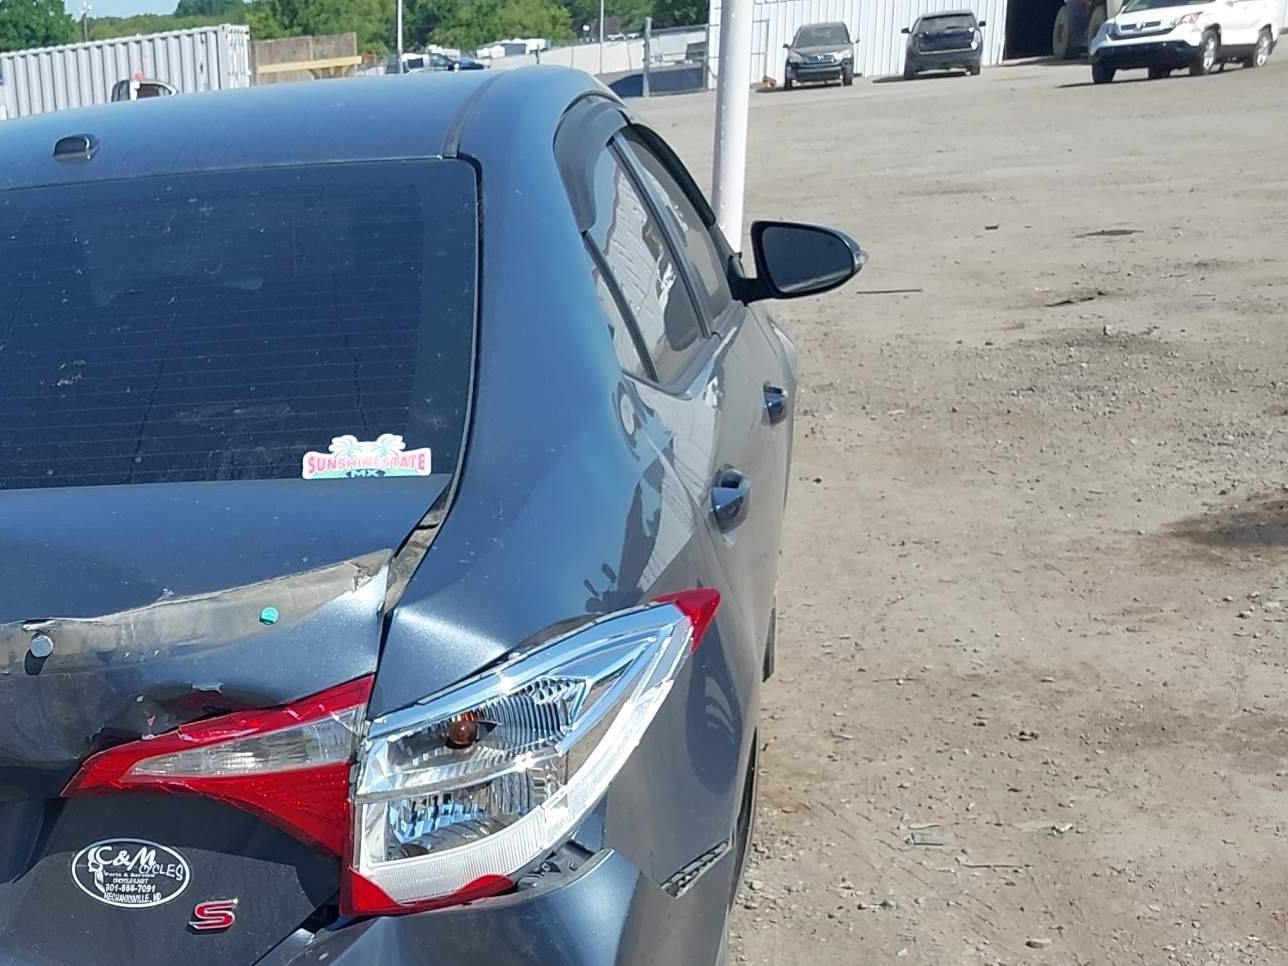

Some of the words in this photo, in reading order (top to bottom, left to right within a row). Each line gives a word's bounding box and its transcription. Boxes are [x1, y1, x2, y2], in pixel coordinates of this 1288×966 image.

[96, 845, 157, 871] C&M
[139, 863, 184, 881] CYCLES
[188, 897, 239, 931] S
